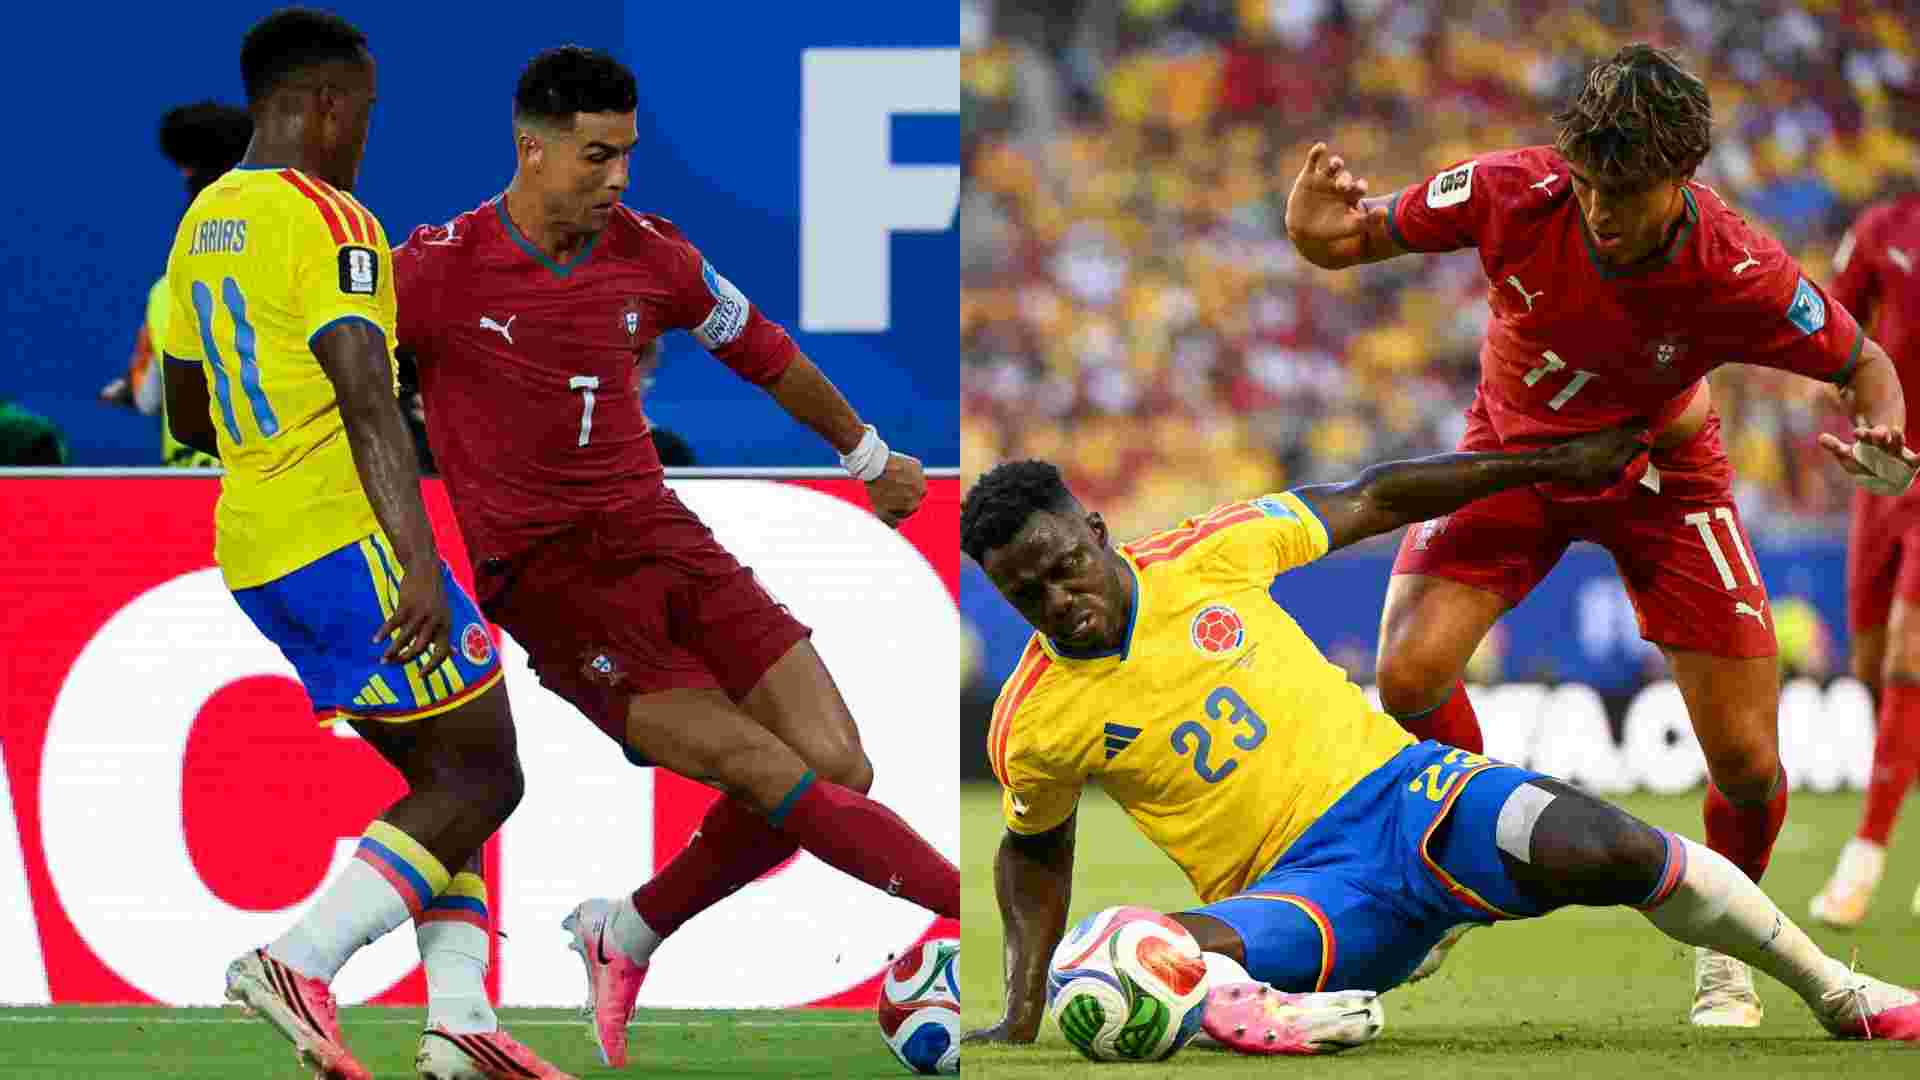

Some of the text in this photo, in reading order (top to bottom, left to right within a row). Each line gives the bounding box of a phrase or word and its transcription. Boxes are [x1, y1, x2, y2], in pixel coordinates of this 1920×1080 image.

[188, 218, 247, 256] J.ARIAS
[191, 276, 278, 445] 11
[569, 376, 600, 448] 7
[1684, 507, 1759, 591] 11
[0, 478, 960, 1007] cD
[1171, 687, 1267, 783] 23
